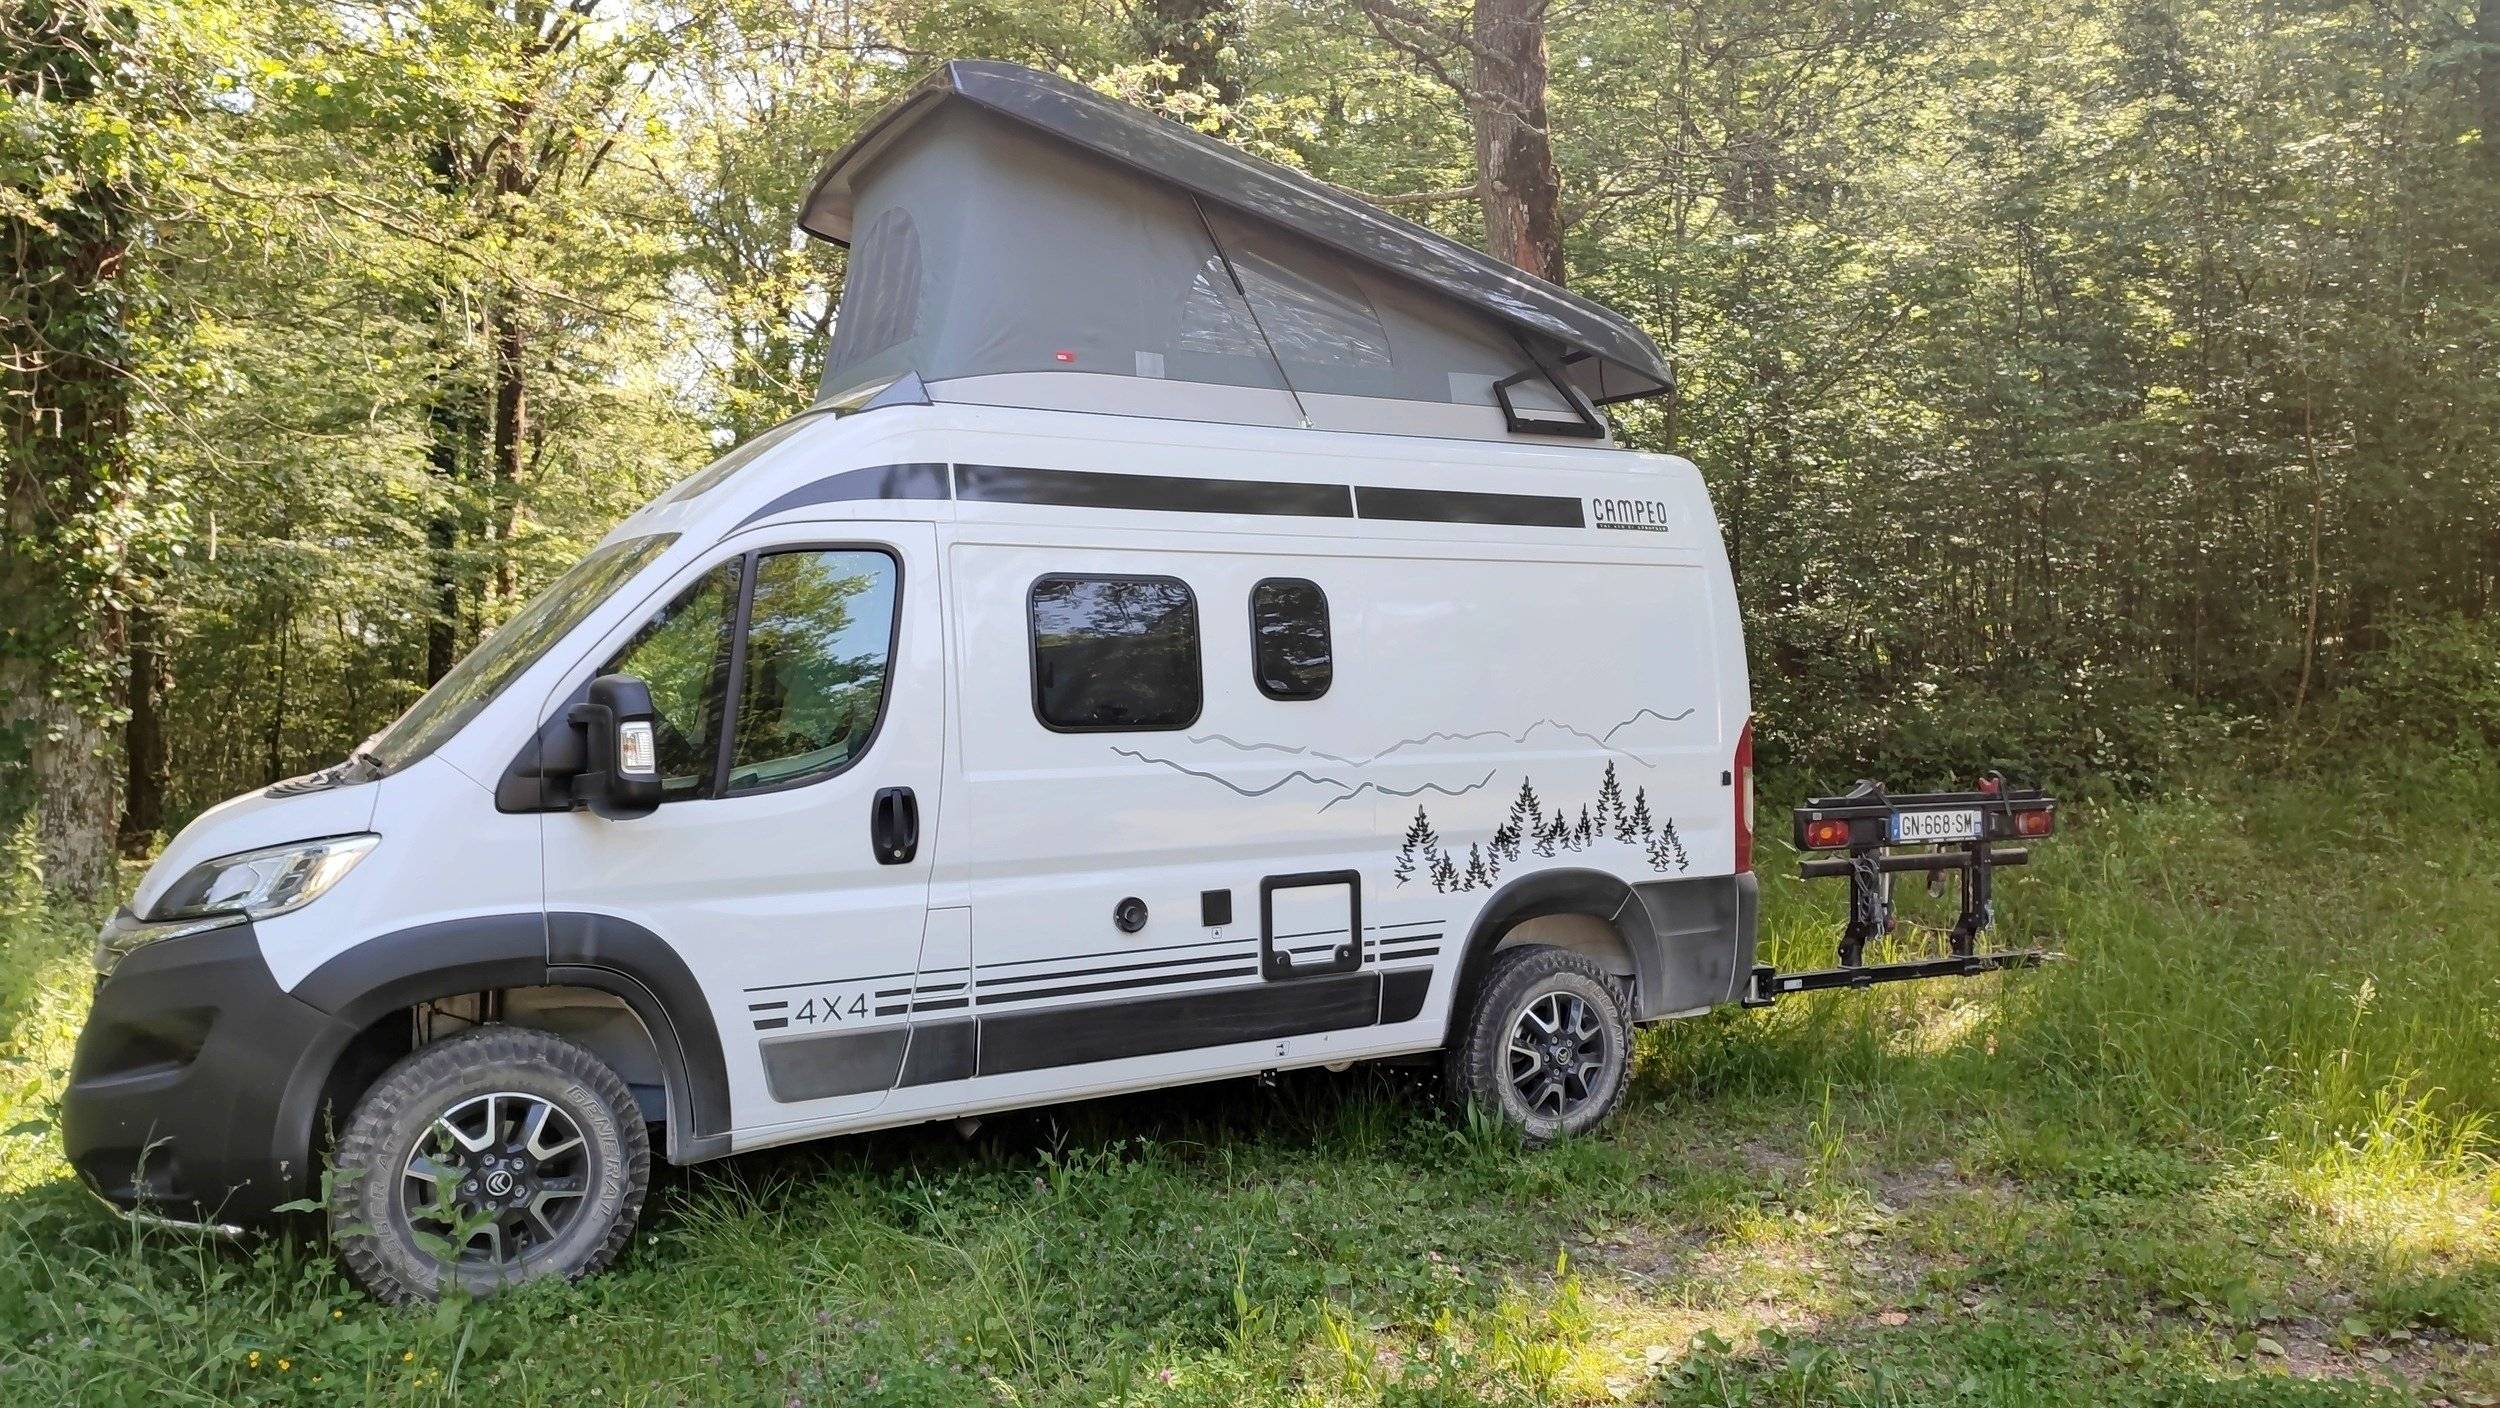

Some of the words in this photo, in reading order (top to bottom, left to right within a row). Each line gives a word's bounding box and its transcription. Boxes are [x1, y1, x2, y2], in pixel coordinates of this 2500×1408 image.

[1593, 498, 1667, 523] CAMPEO
[1903, 813, 1971, 836] GN-668-SM
[795, 993, 869, 1025] 4X4
[564, 1084, 622, 1220] GENERAL
